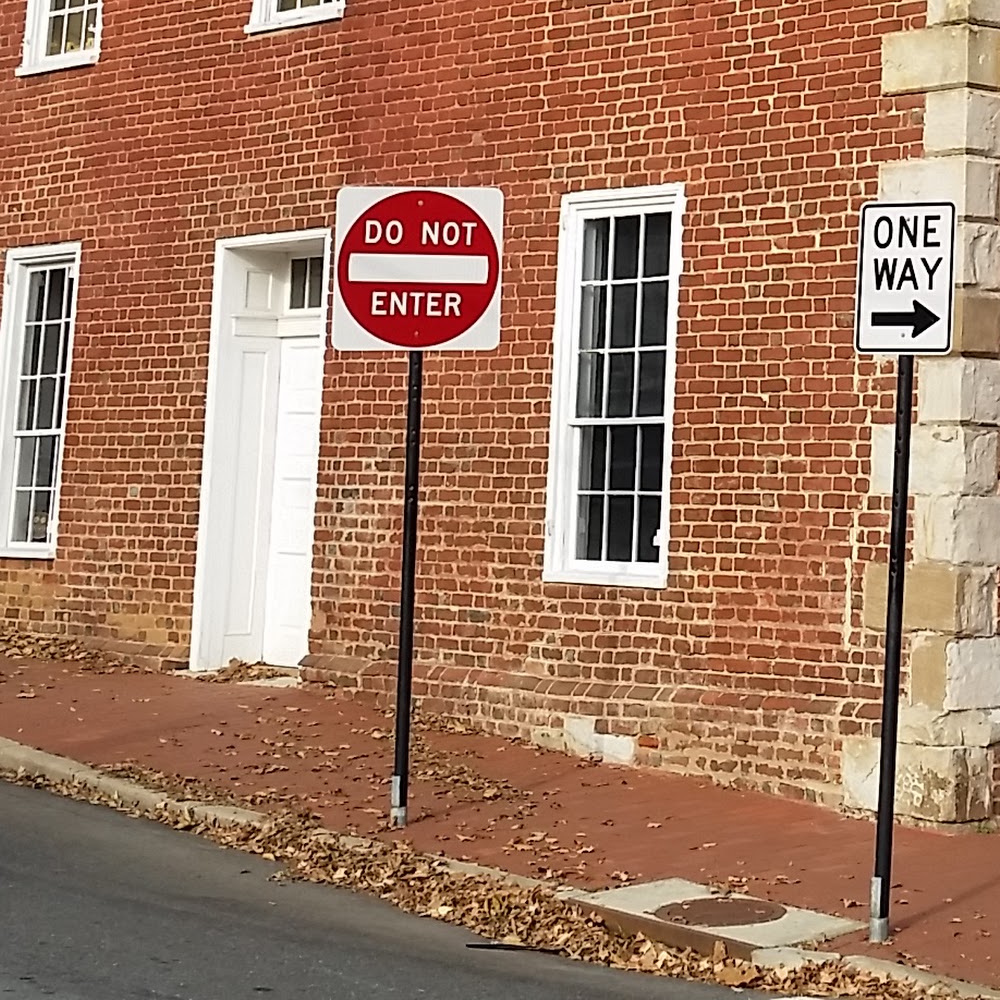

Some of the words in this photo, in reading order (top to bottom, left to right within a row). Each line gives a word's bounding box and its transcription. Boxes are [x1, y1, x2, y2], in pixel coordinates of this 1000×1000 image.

[364, 219, 403, 245] DO
[421, 220, 478, 246] NOT
[873, 214, 941, 249] ONE
[873, 256, 943, 291] WAY
[371, 290, 462, 317] ENTER
